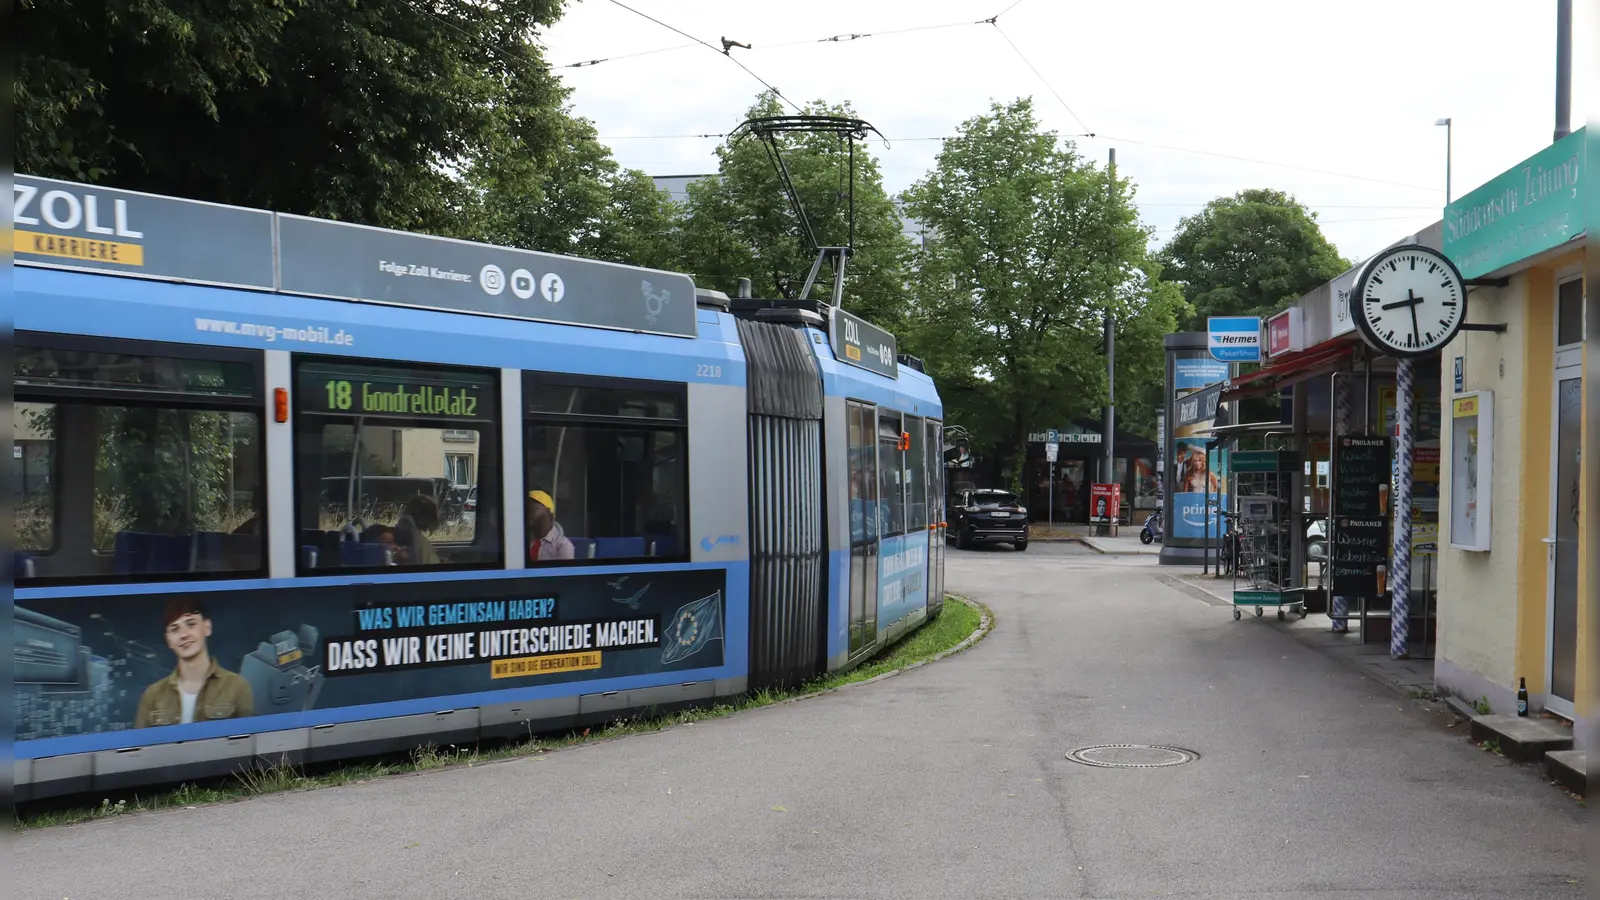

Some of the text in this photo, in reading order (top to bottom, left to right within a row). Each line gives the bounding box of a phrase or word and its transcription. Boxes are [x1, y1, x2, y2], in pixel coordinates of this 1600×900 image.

[1522, 155, 1580, 206] Zeitung
[14, 184, 143, 239] ZOLL
[33, 235, 120, 262] KARRIERE
[379, 260, 408, 276] Folge
[408, 264, 429, 277] Zoll
[194, 316, 354, 347] www.mvg-mobil.de
[1222, 335, 1258, 344] Hermes
[1219, 350, 1257, 358] PaketShop
[696, 363, 722, 378] 2218
[325, 380, 477, 416] 18 Gondrellplatz
[1183, 503, 1217, 517] prime
[359, 598, 555, 630] WAS WIR GEMEINSAM HABEN?
[327, 639, 378, 671] DASS
[382, 636, 421, 666] WIR
[425, 632, 475, 662] KEINE
[479, 623, 592, 658] UNTERSCHIEDE
[596, 619, 659, 647] MACHEN.
[540, 655, 580, 671] GENERATION
